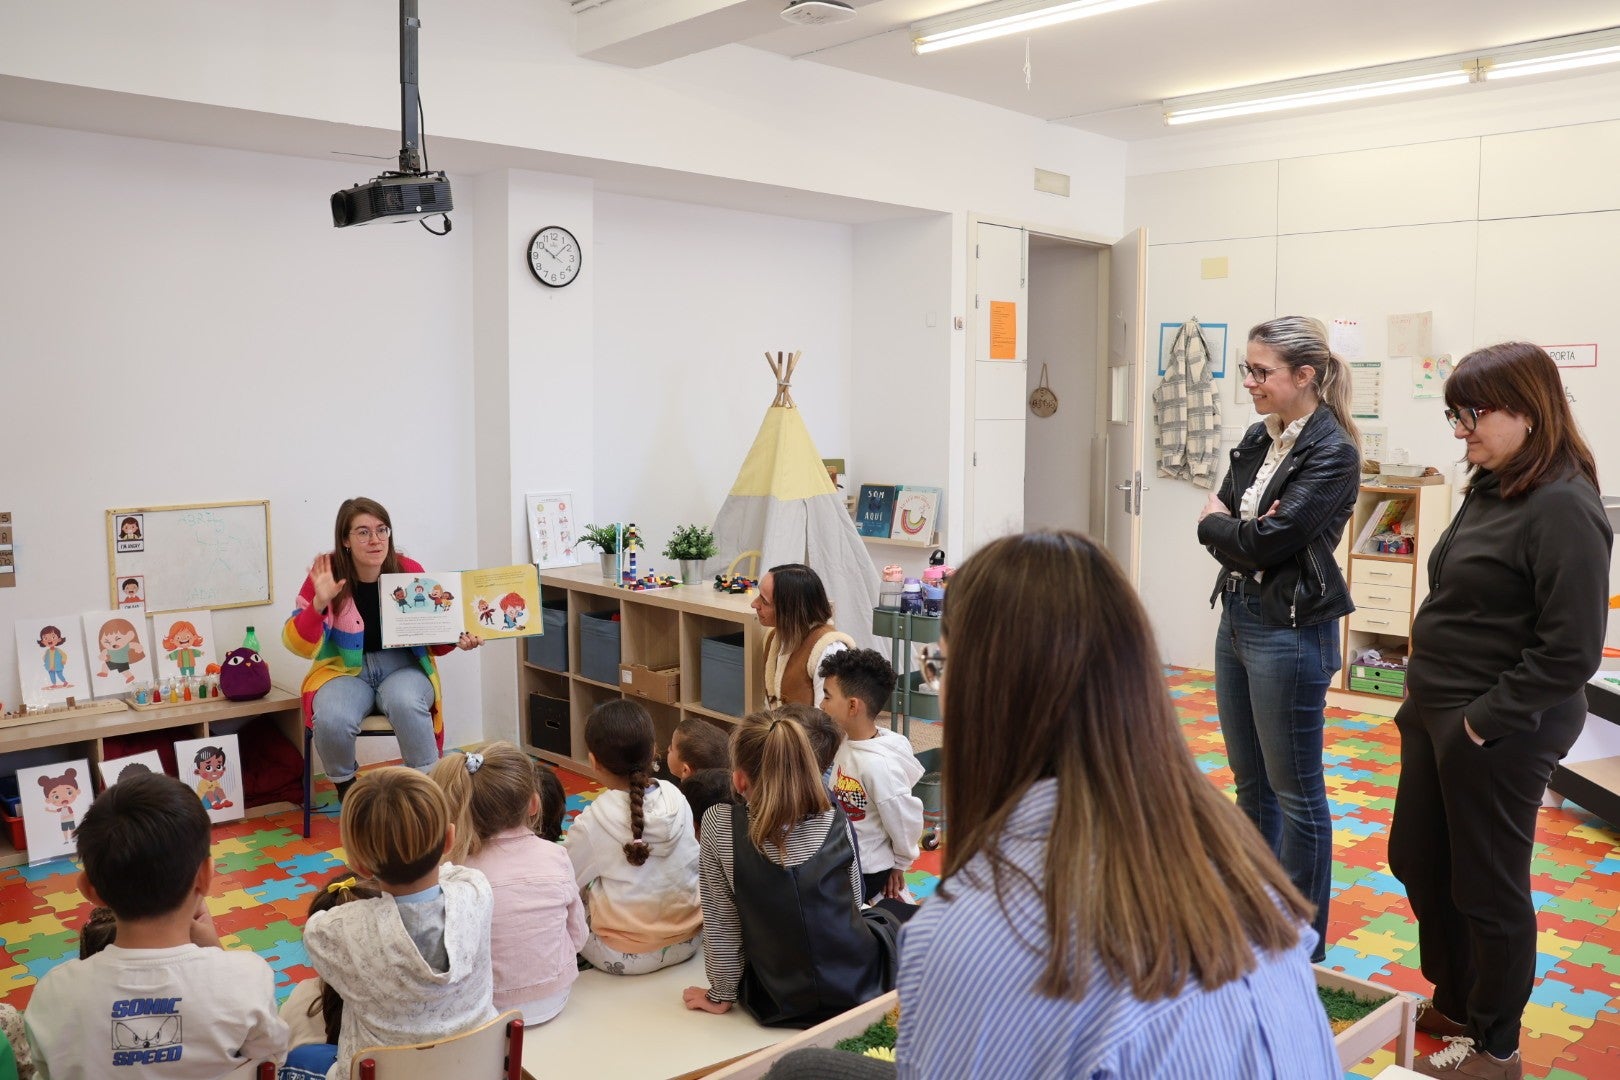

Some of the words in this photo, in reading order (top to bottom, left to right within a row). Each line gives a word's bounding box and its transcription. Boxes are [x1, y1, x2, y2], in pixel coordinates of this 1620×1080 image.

[542, 235, 549, 243] 11
[550, 233, 559, 241] 12
[536, 241, 545, 250] 10
[566, 244, 572, 252] 2
[533, 252, 539, 260] 9
[536, 263, 542, 271] 8
[565, 265, 572, 273] 4
[543, 270, 549, 278] 7
[560, 272, 566, 280] 5
[868, 490, 885, 499] SOM
[111, 997, 183, 1018] SONIC
[112, 1045, 183, 1067] SPEED
